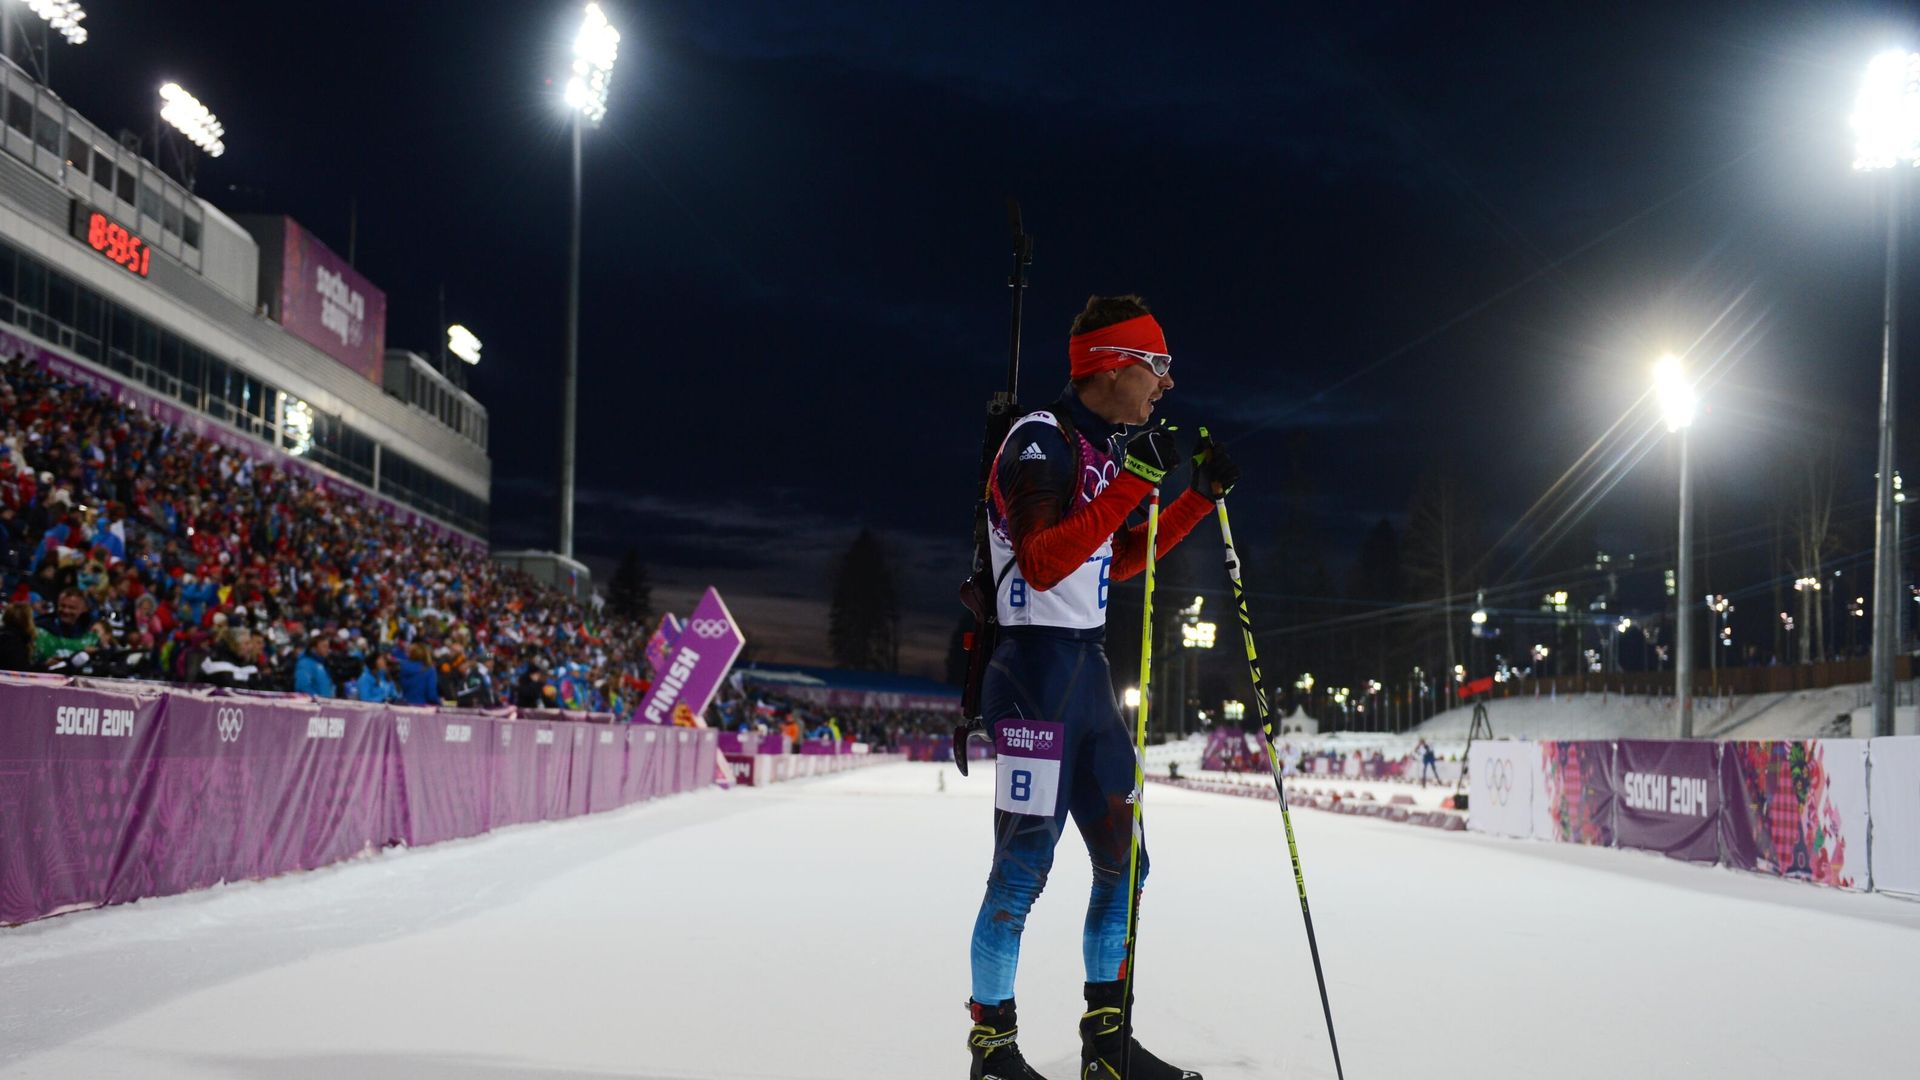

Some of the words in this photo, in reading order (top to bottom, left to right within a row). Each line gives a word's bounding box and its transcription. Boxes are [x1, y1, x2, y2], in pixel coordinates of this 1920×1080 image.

[1019, 452, 1047, 461] adidas
[1010, 578, 1026, 607] 8
[644, 645, 701, 724] FINISH
[55, 706, 98, 736] SOCHI
[101, 709, 134, 737] 2014
[1002, 726, 1054, 741] sochi.ru
[1007, 737, 1034, 751] 2014
[1010, 769, 1032, 802] 8
[1624, 772, 1668, 812] SOCHI
[1669, 775, 1708, 817] 2014
